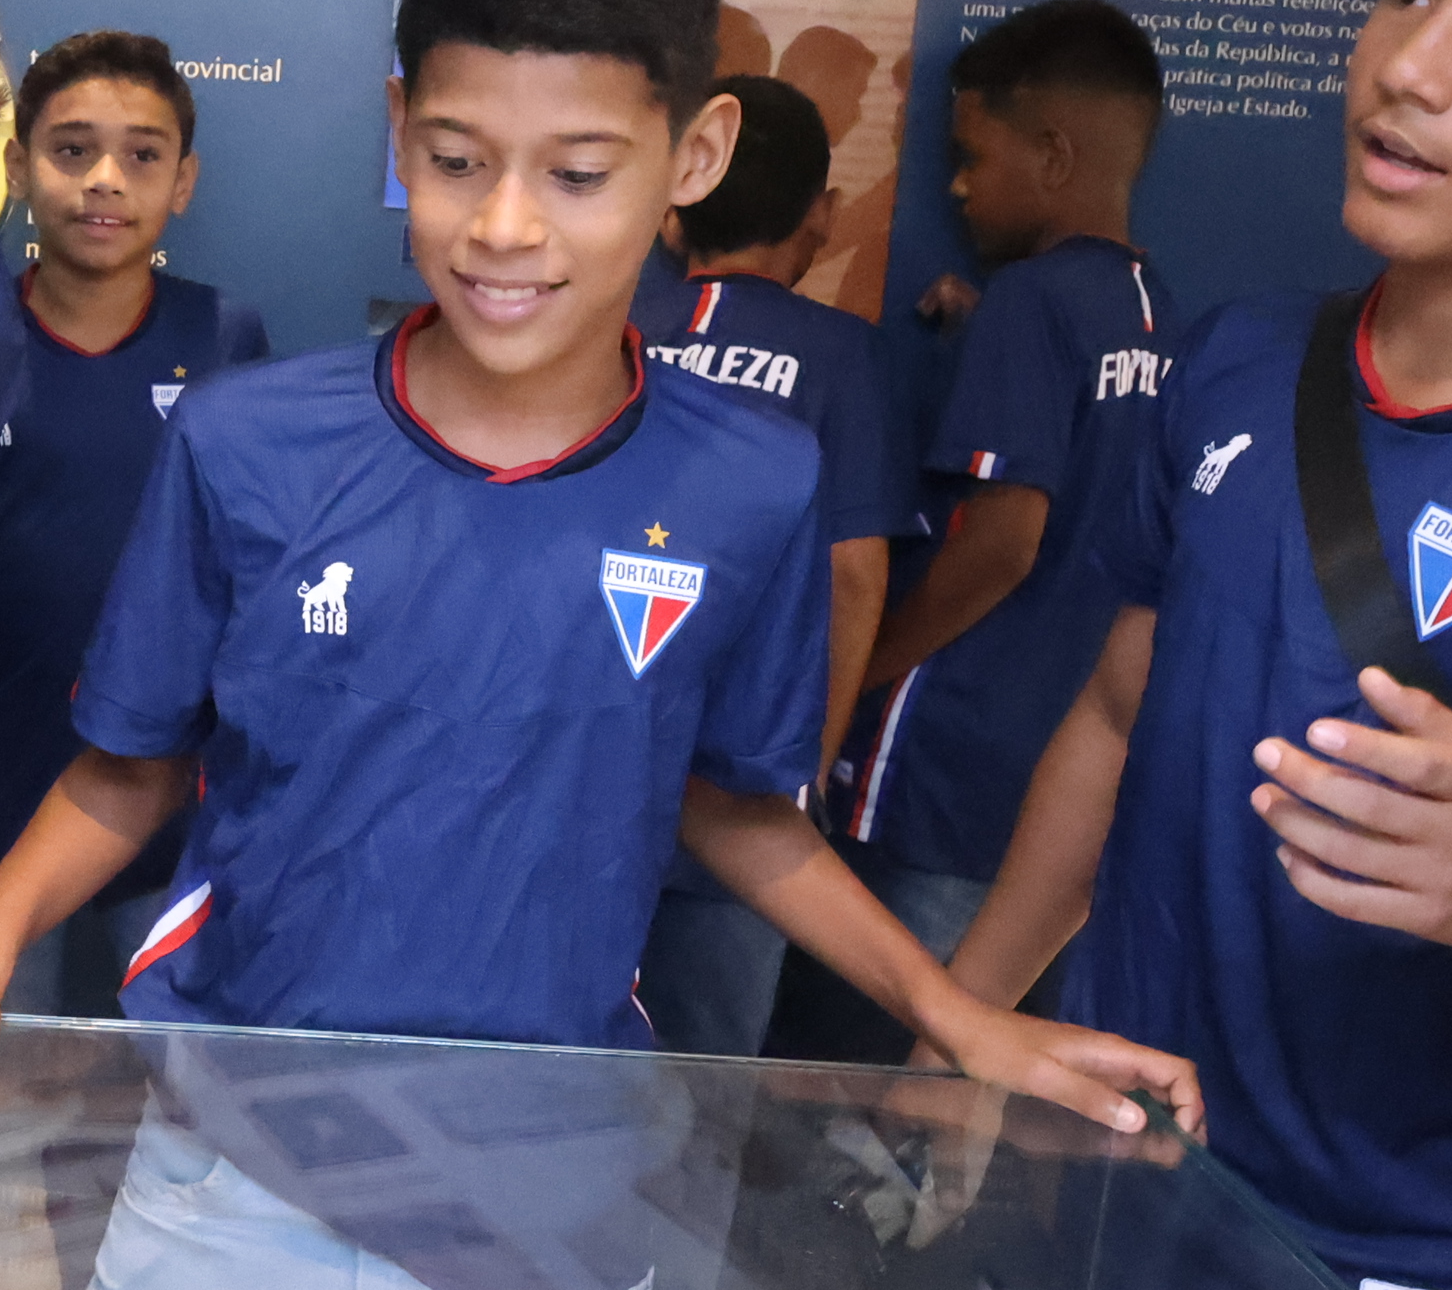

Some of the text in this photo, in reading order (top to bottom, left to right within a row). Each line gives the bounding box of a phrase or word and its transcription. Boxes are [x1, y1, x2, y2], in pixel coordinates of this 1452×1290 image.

[963, 2, 1006, 19] uma
[1185, 11, 1213, 31] do
[1217, 13, 1258, 35] Céu
[1280, 21, 1333, 39] votos
[1185, 39, 1210, 58] da
[1216, 40, 1320, 66] República,
[175, 56, 283, 83] rovincial
[1163, 67, 1232, 89] prática
[1236, 70, 1312, 93] política
[1168, 93, 1312, 120] Igreja Estado.
[606, 559, 700, 593] FORTALEZA
[301, 609, 348, 636] 1918
